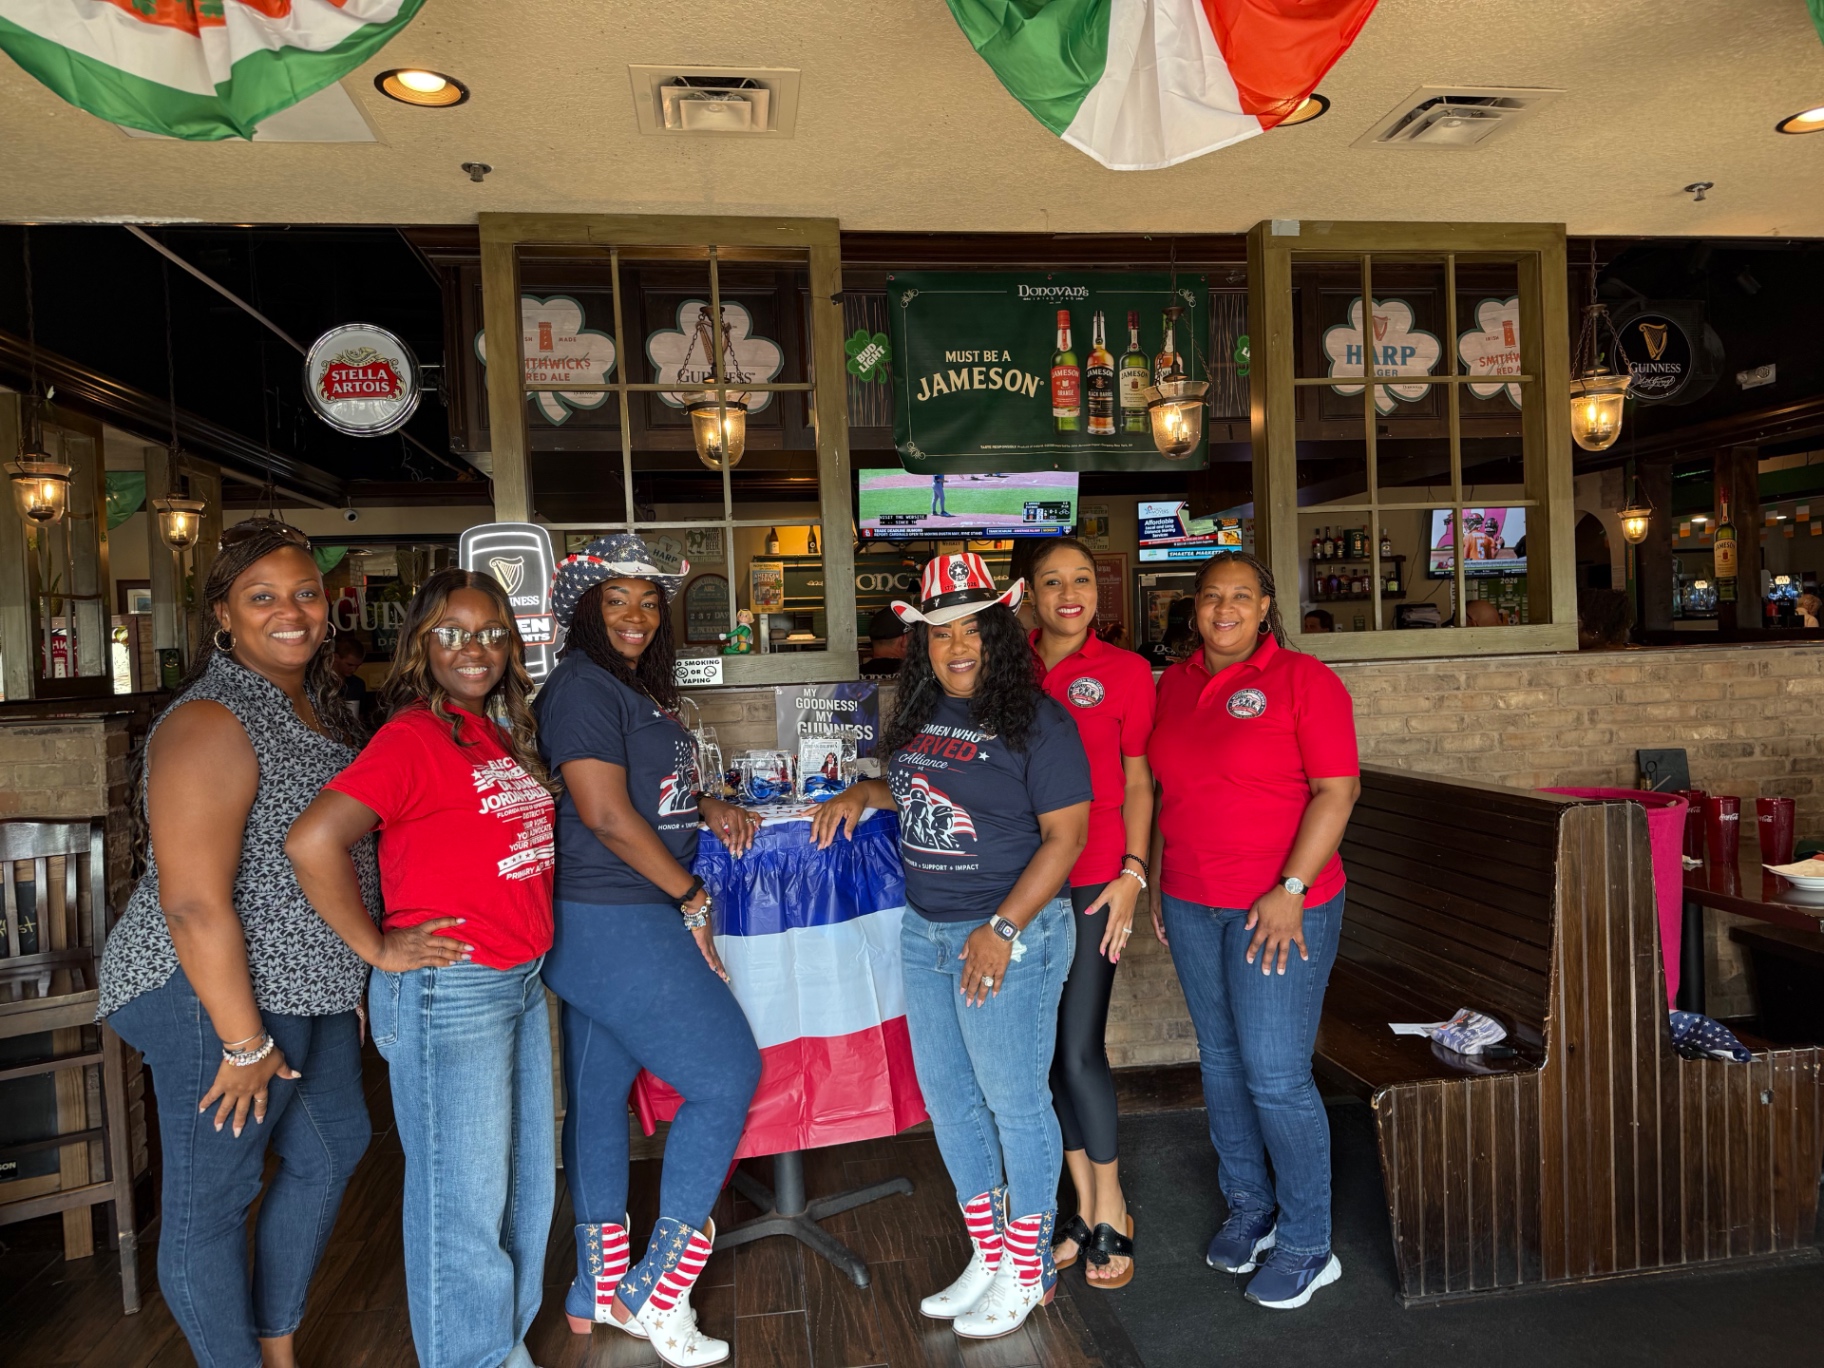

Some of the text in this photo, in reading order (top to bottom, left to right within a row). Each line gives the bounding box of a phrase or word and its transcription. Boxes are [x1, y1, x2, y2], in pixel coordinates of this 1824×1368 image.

[856, 343, 877, 364] BUD
[858, 345, 886, 373] LIGHT
[945, 350, 1011, 363] MUST BE A
[1051, 369, 1079, 378] JAMESON
[1087, 368, 1114, 378] JAMESON
[1376, 369, 1398, 377] GER
[1496, 367, 1514, 376] RED
[1630, 362, 1682, 373] GUINNESS
[331, 369, 389, 381] STELLA
[526, 373, 570, 381] RED ALE
[677, 369, 752, 384] GUIESS
[1121, 370, 1148, 379] JAMESON
[332, 382, 390, 394] ARTOIS
[917, 367, 1041, 401] JAMESON
[1144, 518, 1174, 526] Affordable
[1715, 541, 1736, 551] JAMESON
[653, 548, 678, 563] HARP
[803, 688, 817, 697] MY
[795, 697, 858, 712] GOODNESS!
[815, 711, 834, 723] MY
[797, 721, 874, 741] GUINNESS
[921, 724, 980, 743] OMEN WHO
[901, 734, 978, 762] ERVED
[898, 752, 949, 769] Alliance
[922, 863, 947, 871] SUPPORT
[955, 863, 979, 871] IMPACT
